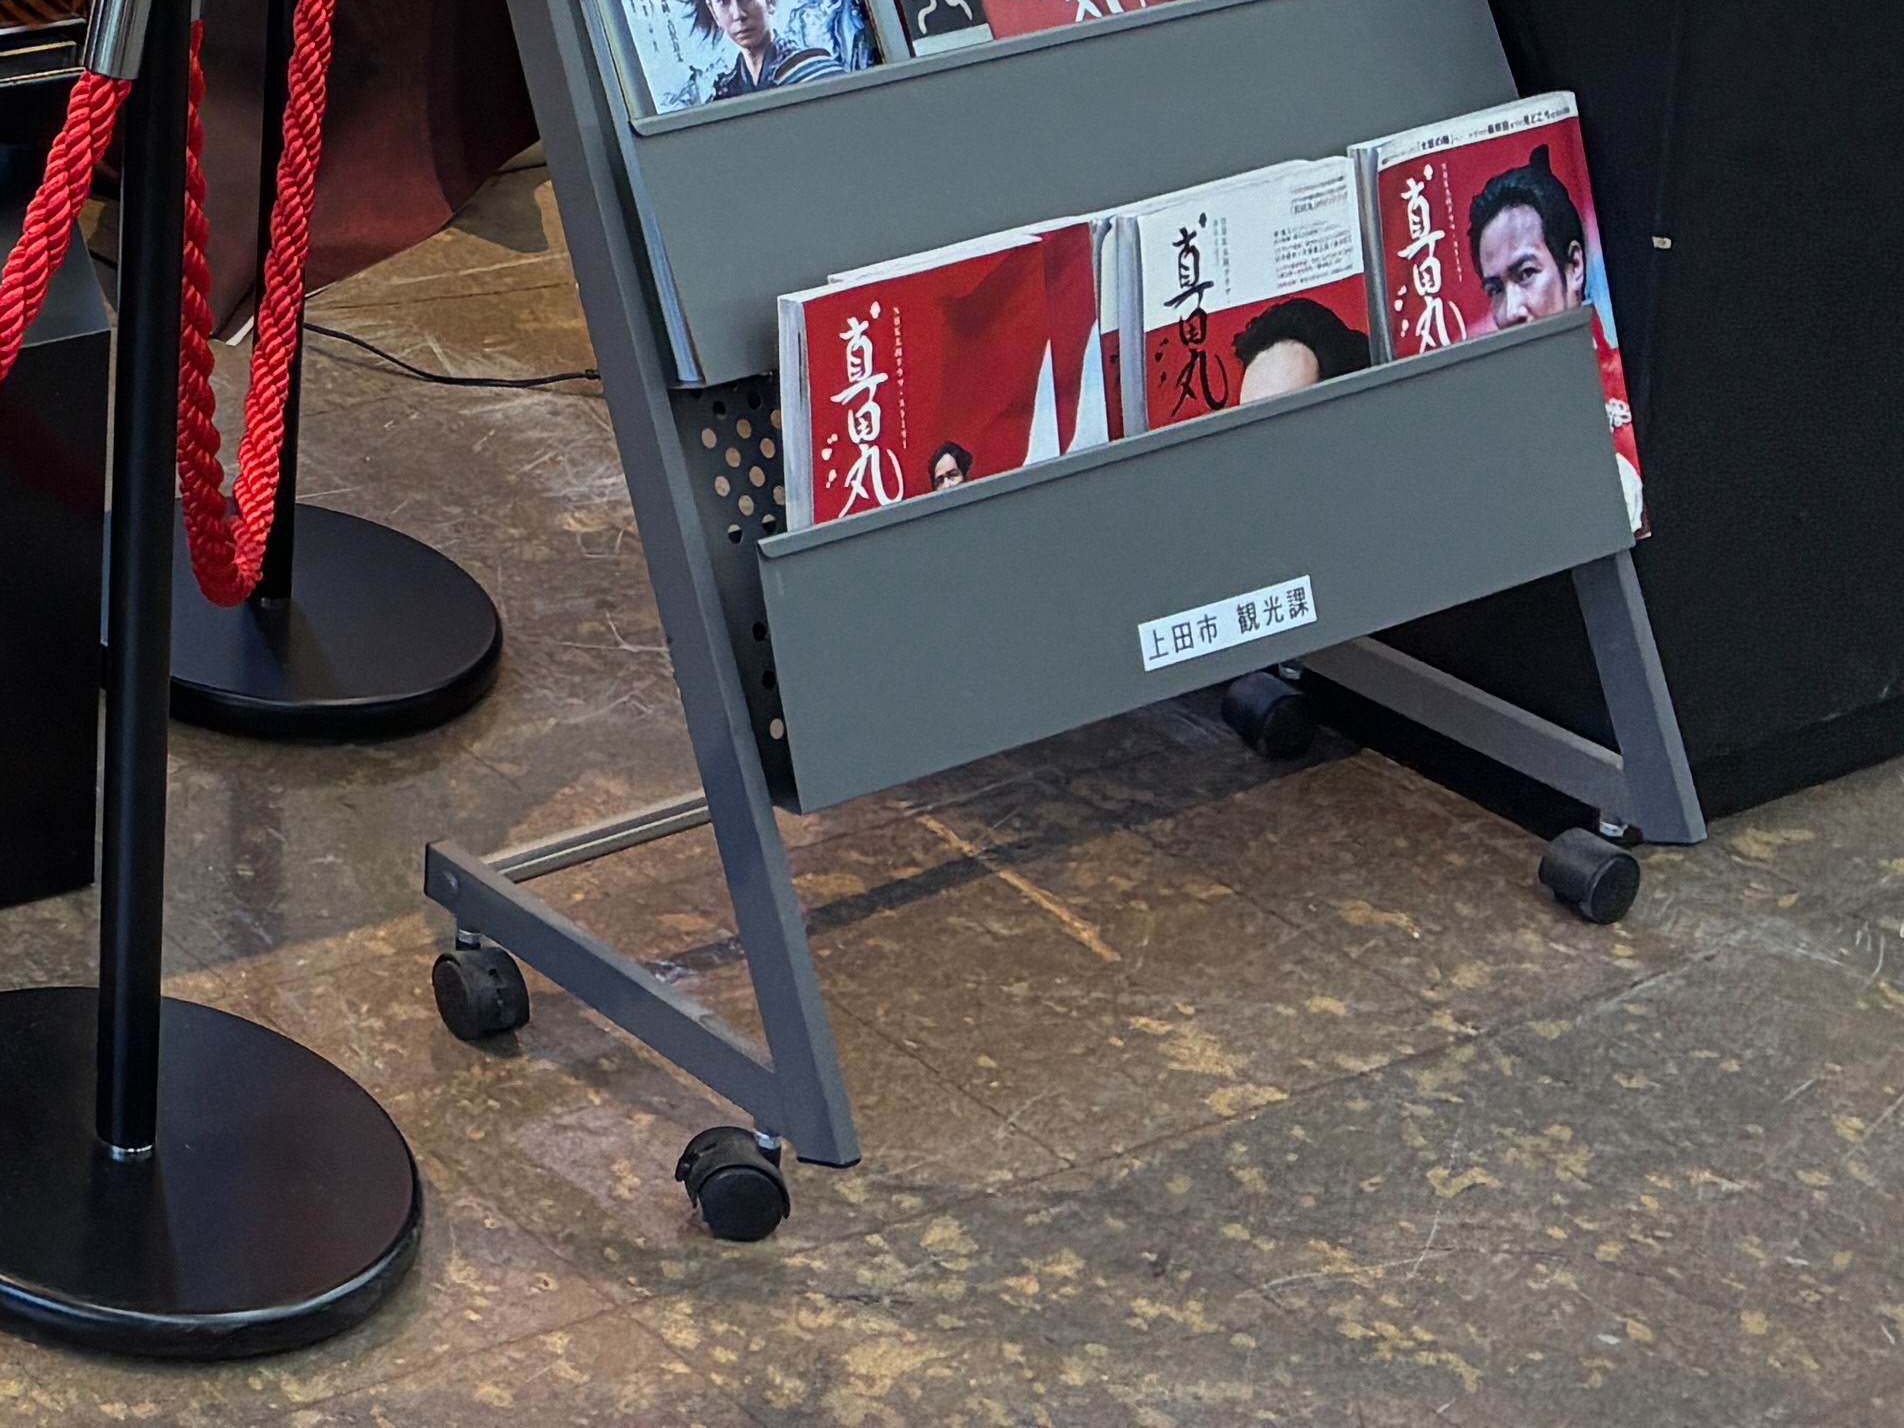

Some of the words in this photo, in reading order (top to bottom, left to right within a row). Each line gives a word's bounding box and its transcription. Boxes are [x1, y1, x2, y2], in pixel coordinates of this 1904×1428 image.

[830, 301, 904, 518] 真田丸
[1163, 212, 1229, 417] 真田丸
[1149, 613, 1218, 660] 上田市
[1236, 586, 1309, 635] 観光課
